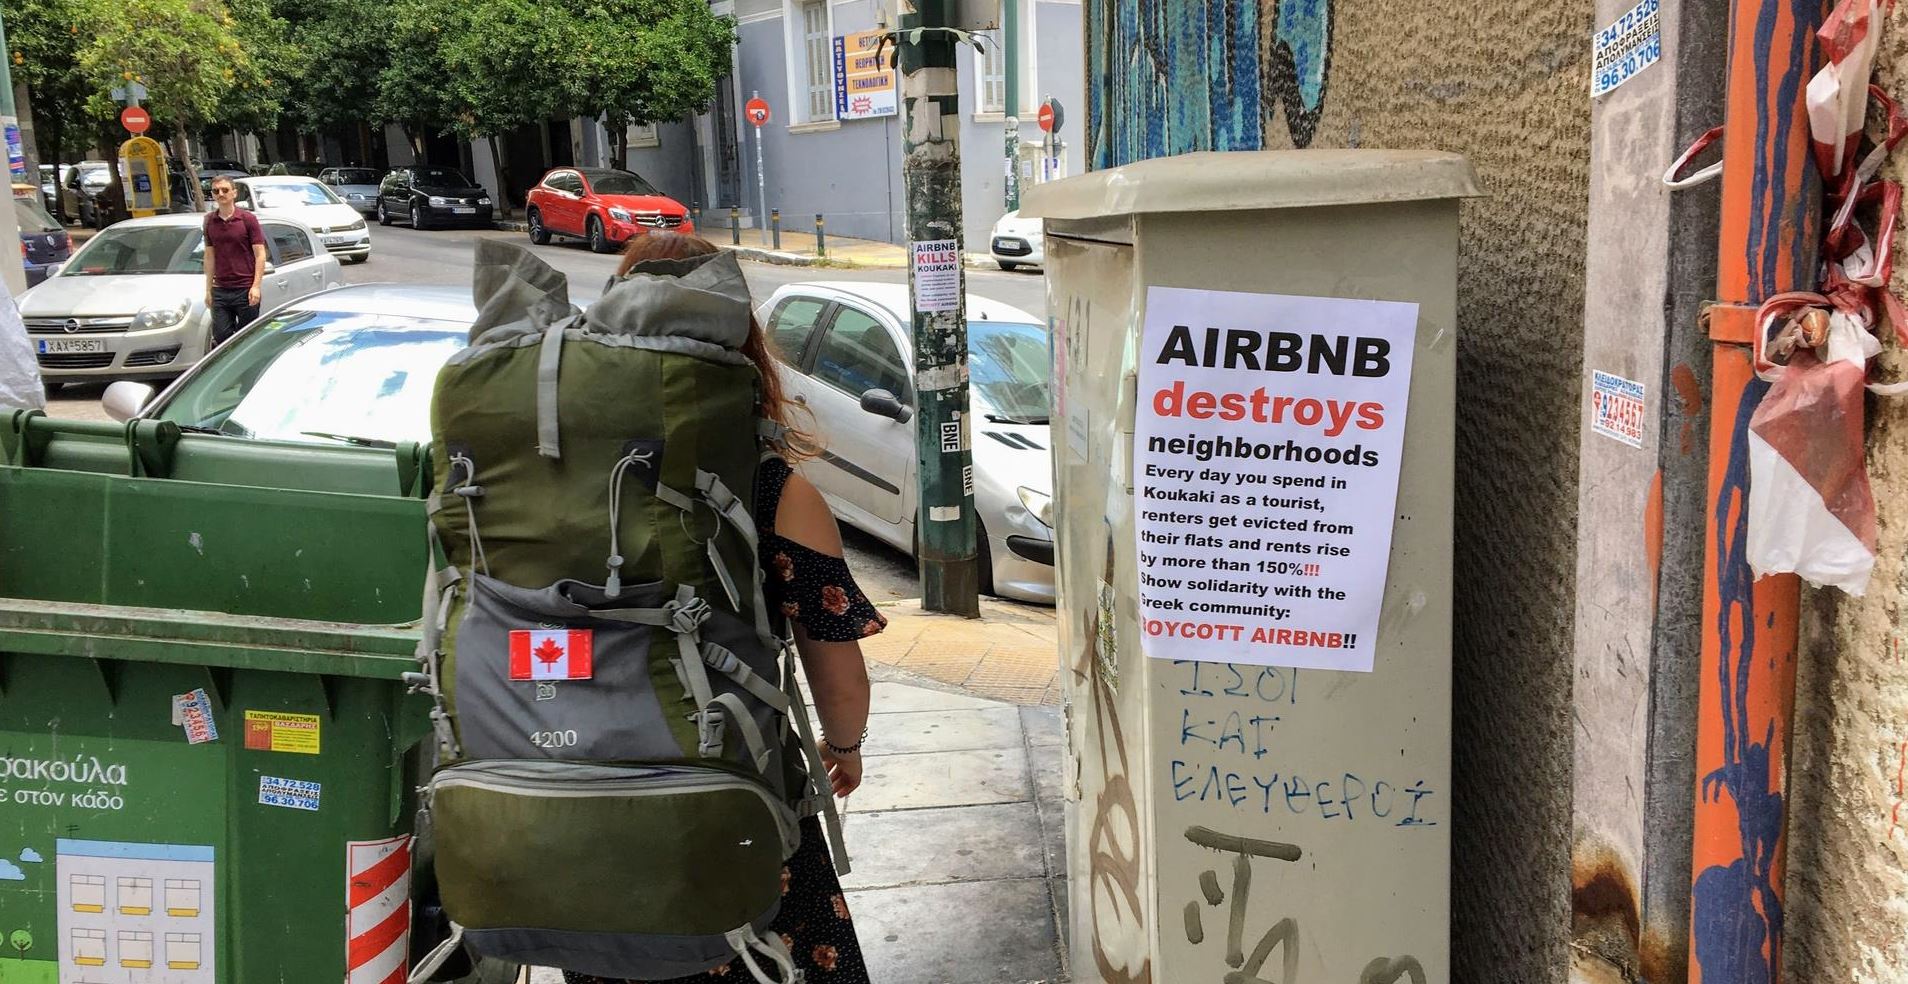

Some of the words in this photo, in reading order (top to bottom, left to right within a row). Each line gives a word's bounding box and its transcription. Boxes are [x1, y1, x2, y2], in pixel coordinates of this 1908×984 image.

[1595, 23, 1659, 70] ΑΠΟΛΥΜΑΝΣΕΙΣ
[1596, 13, 1659, 61] ΑΠΟΦΡΑΞΕΙΣ
[855, 55, 885, 69] ΘΕΩΡΗΤΗ
[916, 242, 956, 252] AIRBNB
[917, 252, 956, 264] KILLS
[917, 264, 957, 272] KOUKAKI
[1156, 325, 1390, 377] AIRBNB
[1153, 380, 1385, 437] destroys
[943, 424, 958, 451] BNE
[1149, 434, 1378, 466] neighborhoods
[964, 467, 973, 494] BNE
[1146, 464, 1194, 482] Every
[1200, 469, 1231, 484] day
[1236, 473, 1267, 485] you
[1272, 476, 1325, 488] spend
[1331, 477, 1346, 489] in
[1144, 486, 1214, 502] Koukaki
[1220, 495, 1240, 504] as
[1246, 497, 1256, 505] a
[1263, 495, 1324, 512] tourist,
[1143, 511, 1203, 524] renters
[1209, 515, 1237, 528] get
[1243, 517, 1308, 531] evicted
[1313, 520, 1353, 534] from
[1142, 530, 1180, 544] their
[1185, 534, 1223, 547] flats
[1229, 539, 1261, 550] and
[1266, 542, 1311, 553] rents
[1317, 543, 1350, 556] rise
[1141, 551, 1157, 567] by
[1162, 557, 1206, 568] more
[1212, 558, 1250, 571] than
[1257, 560, 1320, 577] 150%!!!
[1187, 579, 1268, 597] solidarity
[1274, 585, 1311, 598] with
[1318, 588, 1345, 600] the
[1189, 603, 1290, 620] community:
[1143, 618, 1244, 641] OYCOTT
[1251, 628, 1356, 649] AIRBNB!!
[530, 729, 578, 748] 4200
[1181, 709, 1280, 759] ΚΑΙ
[72, 788, 124, 810] κάδο
